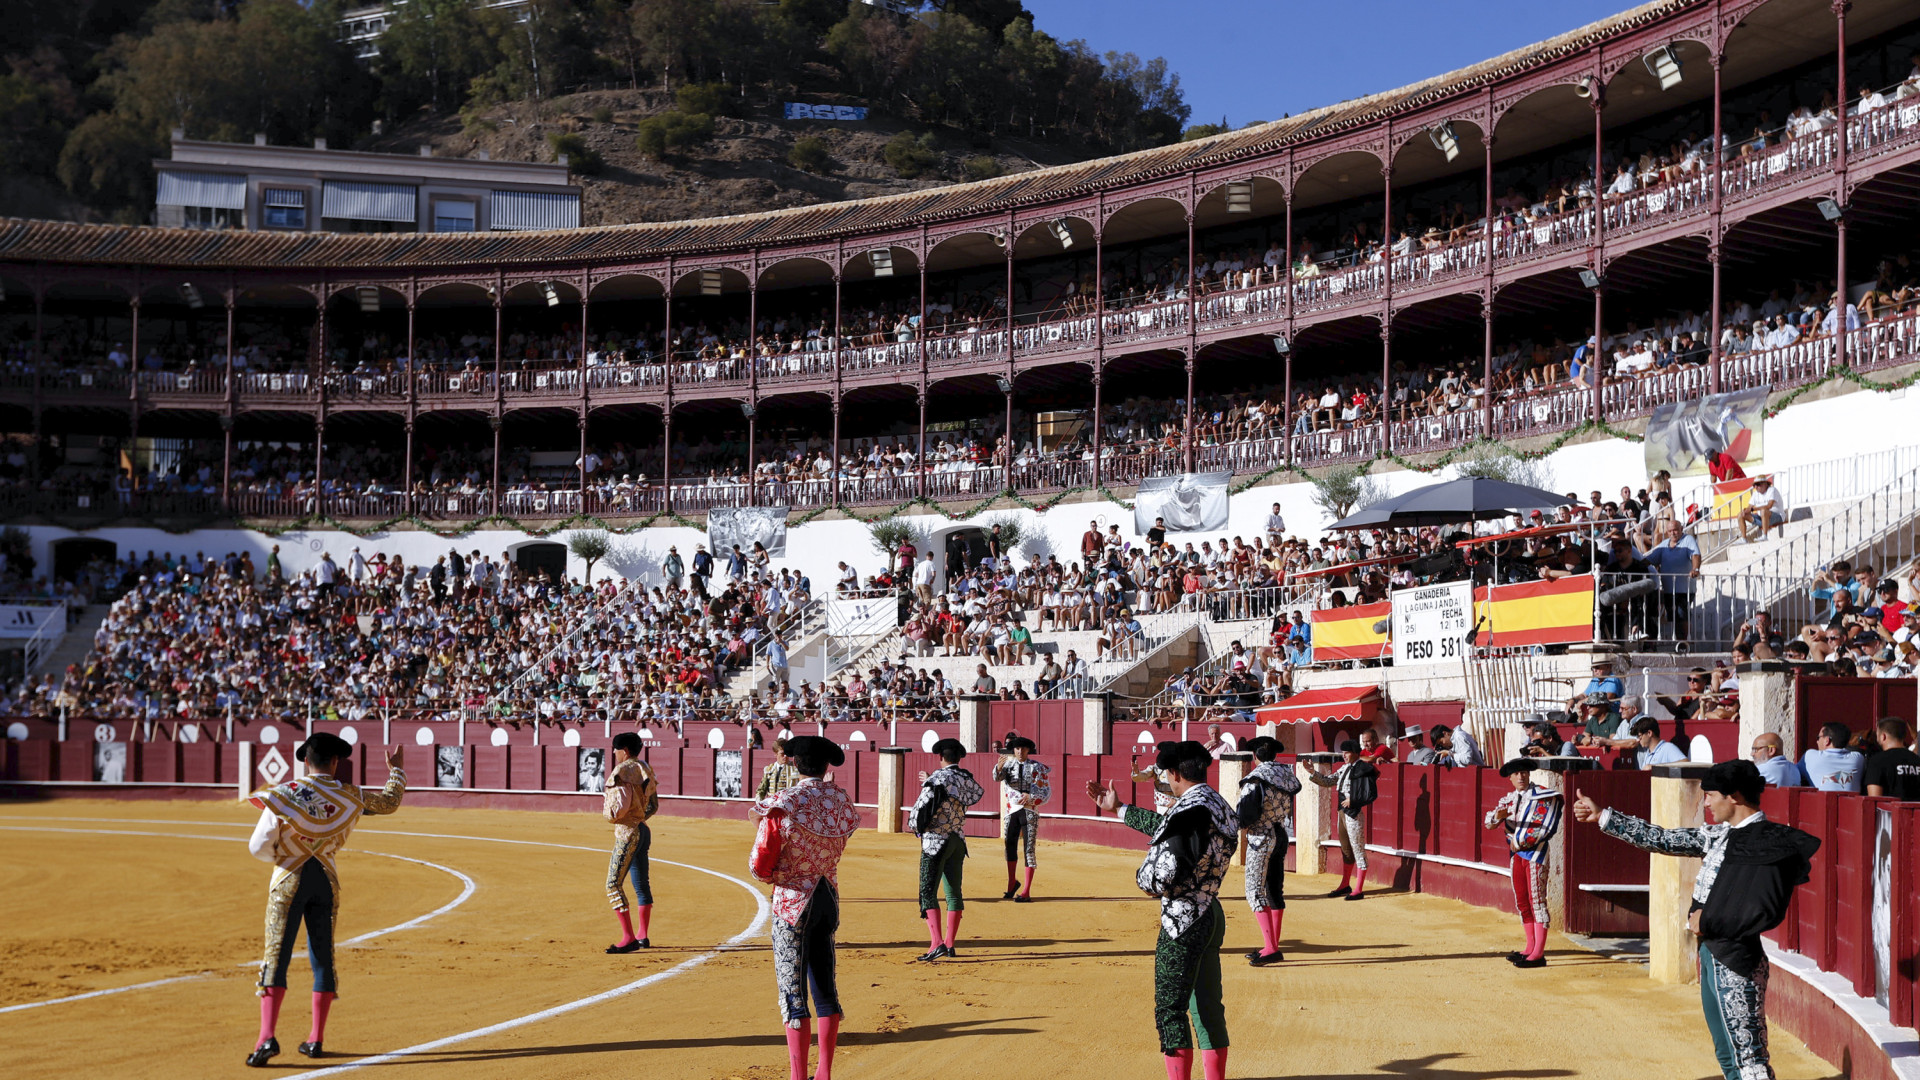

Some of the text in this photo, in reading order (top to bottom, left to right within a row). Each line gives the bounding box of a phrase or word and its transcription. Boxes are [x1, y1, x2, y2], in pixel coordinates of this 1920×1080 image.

[1414, 587, 1451, 601] GANADERIA
[1442, 608, 1463, 619] FECHA
[1405, 618, 1465, 634] 25 12 18
[1406, 636, 1461, 660] PESO 581
